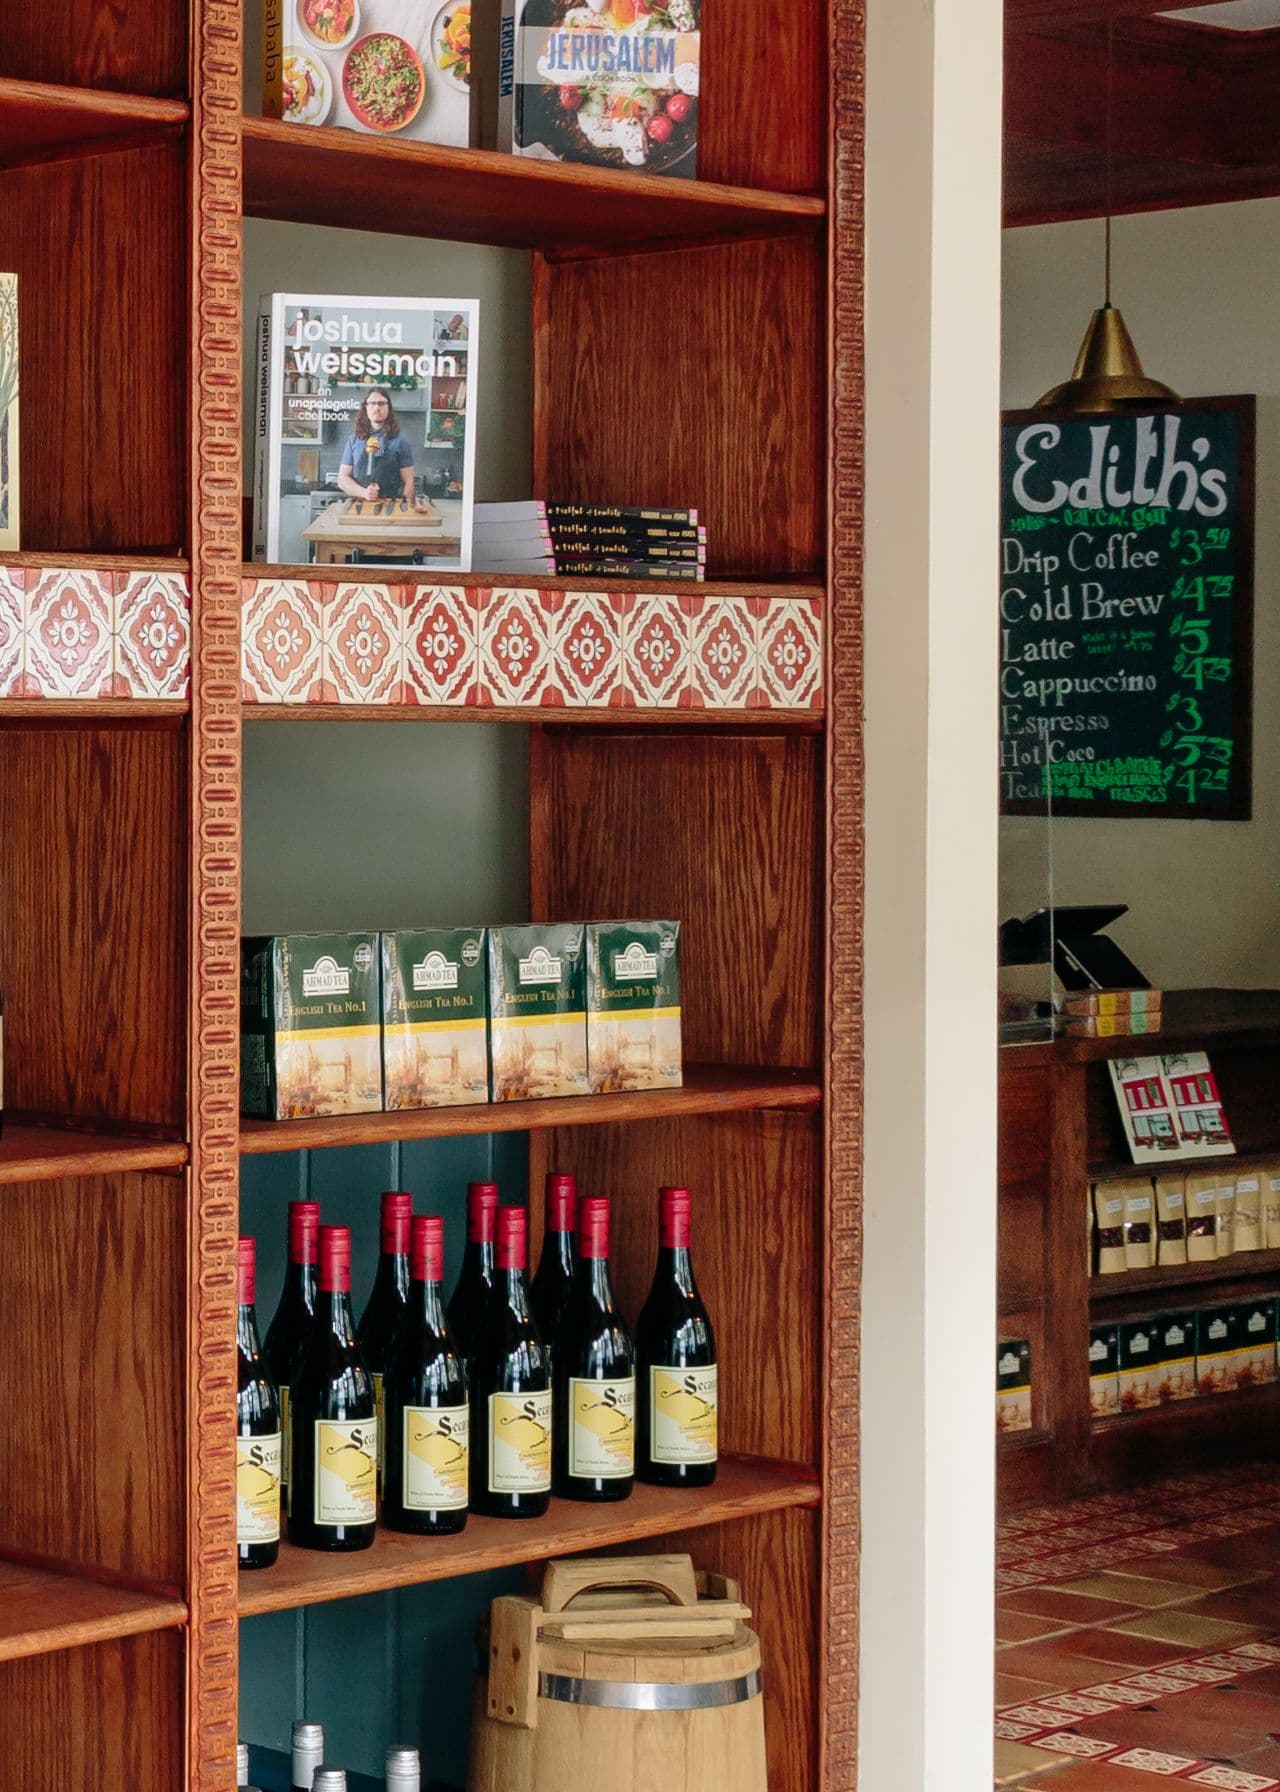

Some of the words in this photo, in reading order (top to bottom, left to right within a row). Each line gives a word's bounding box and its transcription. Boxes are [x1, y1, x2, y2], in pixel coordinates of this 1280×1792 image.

[266, 0, 280, 81] sababa
[500, 15, 514, 96] JERUSALEM
[547, 33, 675, 74] JERUSALEM
[292, 311, 402, 350] joshua
[294, 346, 456, 377] weissman
[288, 399, 360, 411] unapologetic
[318, 388, 331, 396] an
[298, 409, 350, 422] cookbook
[1012, 414, 1228, 516] Edith's
[1002, 538, 1059, 585] Drip
[1068, 532, 1159, 571] Coffee
[1000, 585, 1072, 622] Cold
[1081, 582, 1164, 621] Brew
[1002, 628, 1075, 662] Latte
[1170, 613, 1211, 655] $5
[1001, 666, 1157, 707] Cappuccino
[1002, 704, 1109, 740] Espresso
[1166, 692, 1203, 732] $3
[1000, 740, 1040, 766] Hot
[1048, 739, 1095, 762] Coco
[1000, 771, 1040, 800] Tea
[306, 976, 332, 987] AHMAD
[334, 975, 347, 985] TEA
[416, 970, 441, 981] AHMAD
[443, 969, 456, 979] TEA
[522, 965, 546, 976] AHMAD
